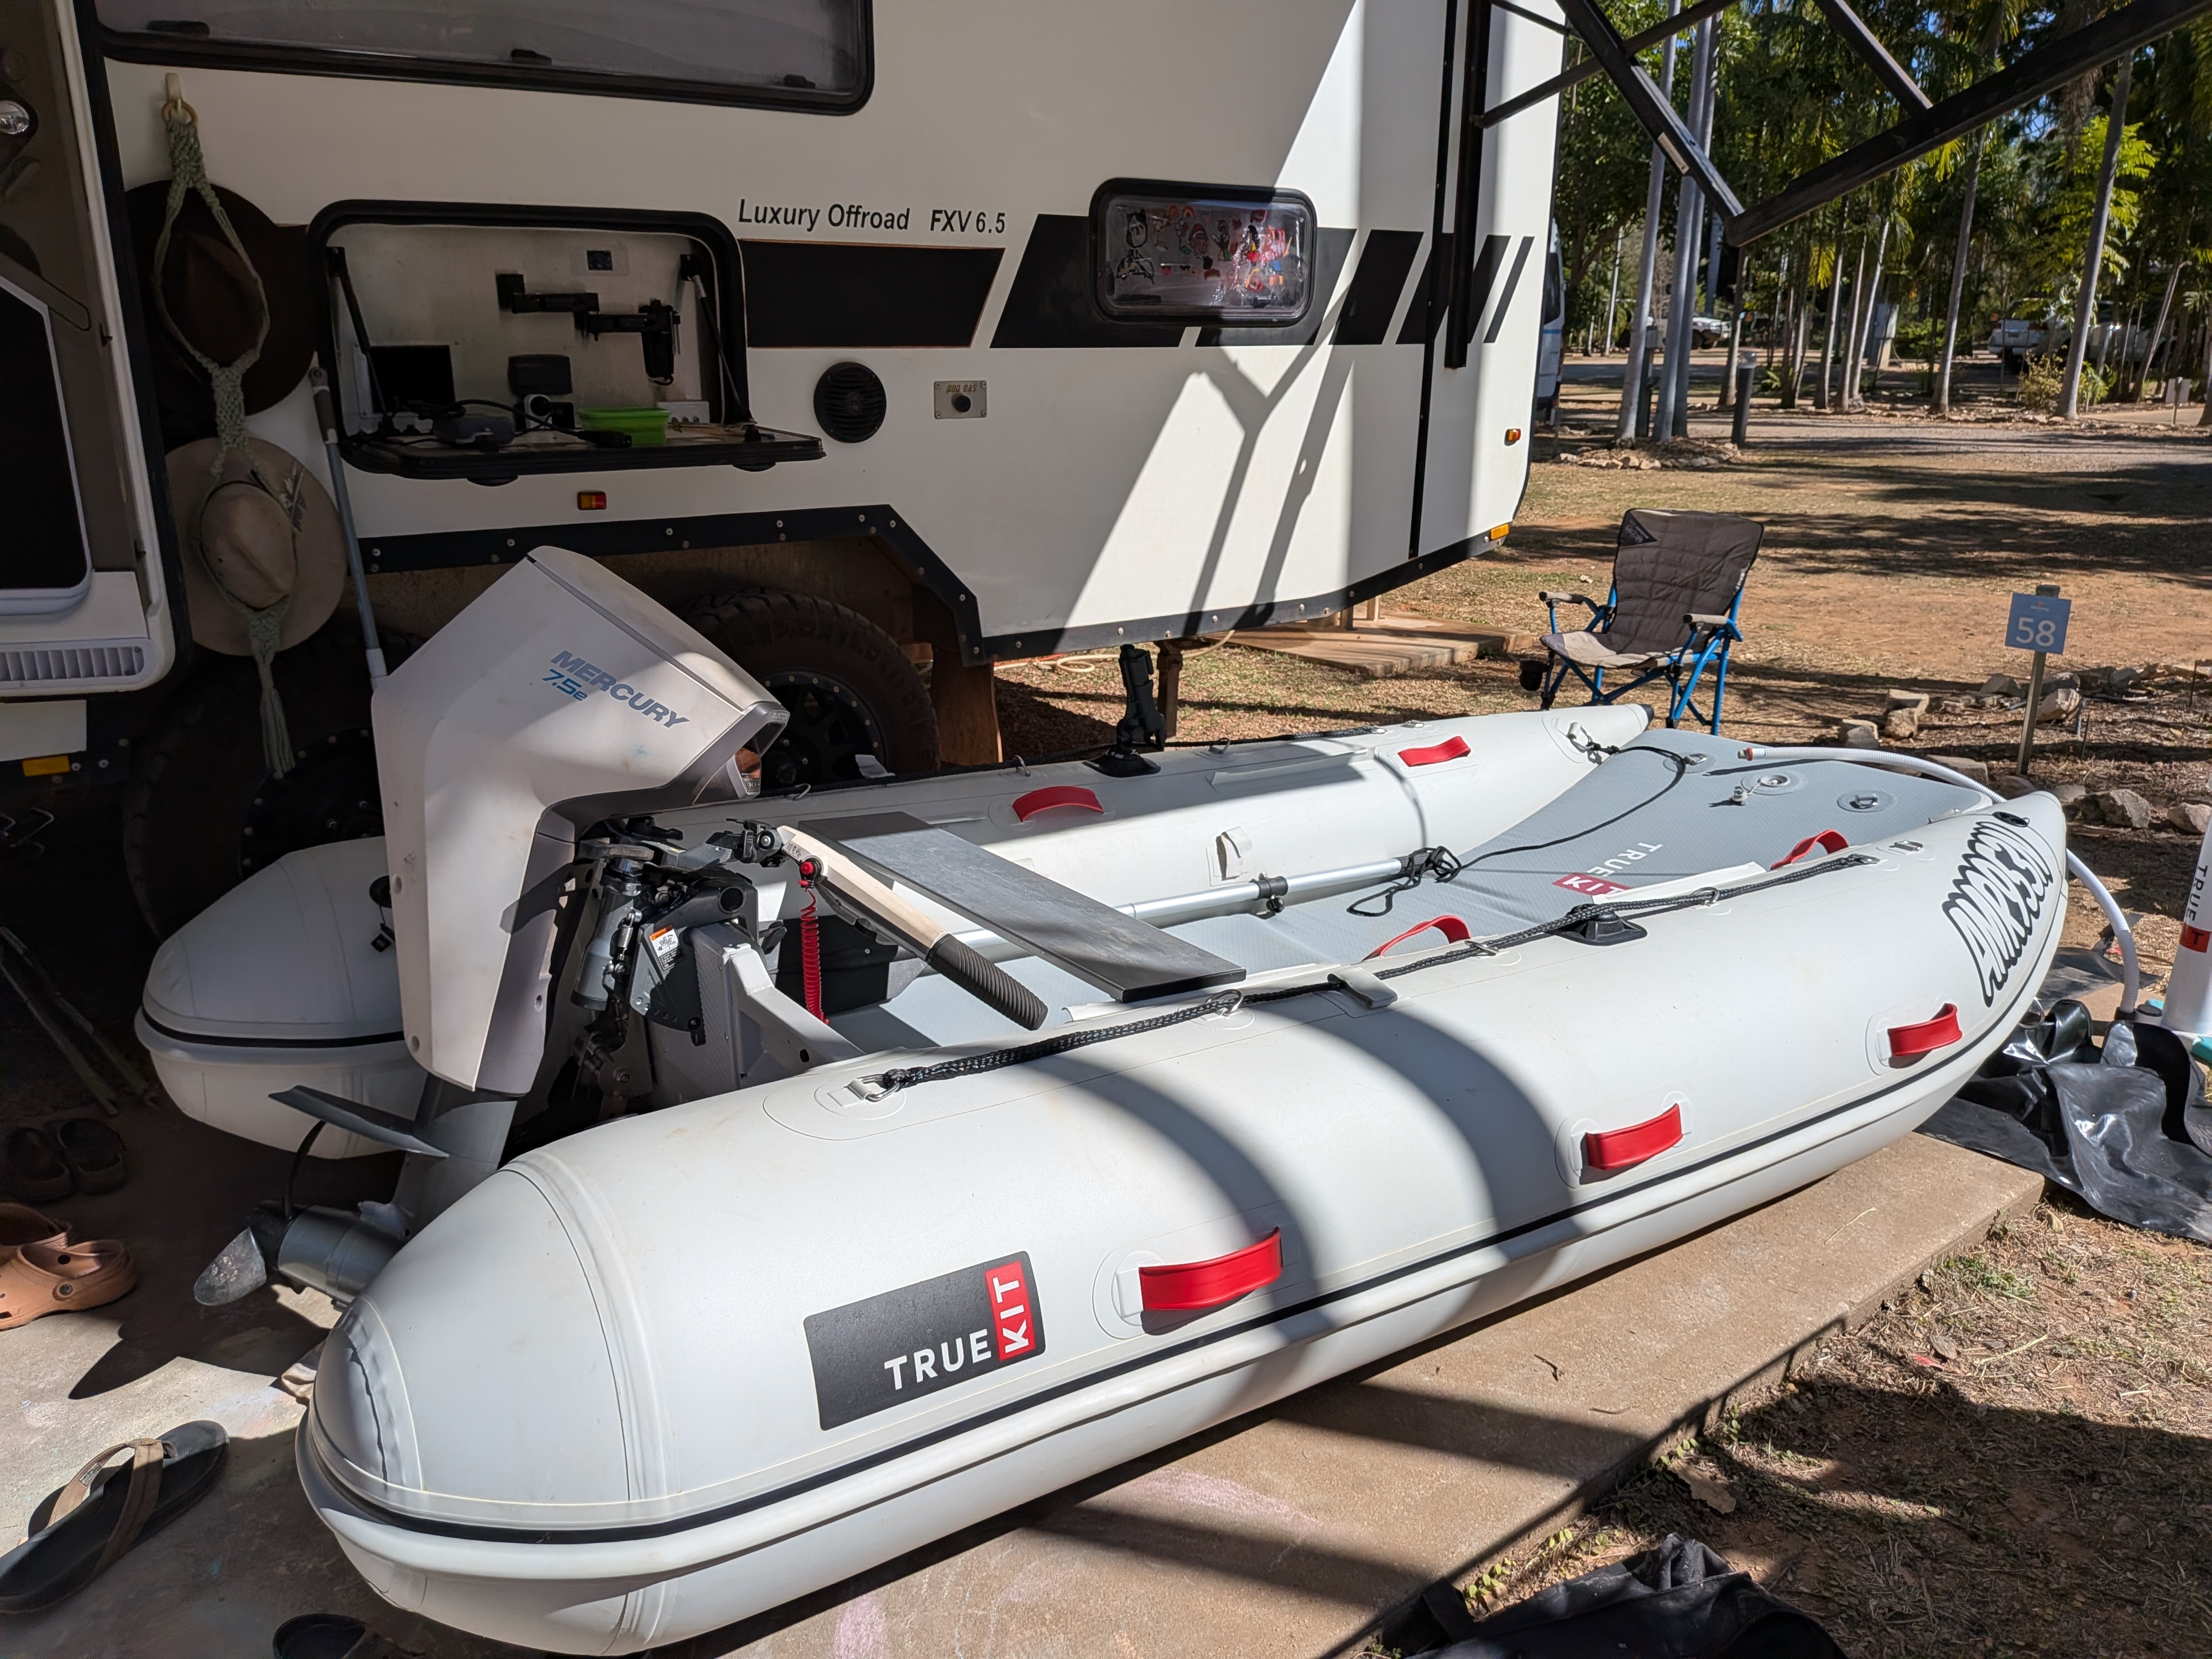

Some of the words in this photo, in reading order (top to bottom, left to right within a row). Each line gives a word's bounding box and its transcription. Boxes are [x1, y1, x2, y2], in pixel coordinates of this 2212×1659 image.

[738, 199, 821, 232] Luxury
[828, 203, 910, 230] Offroad
[930, 209, 972, 233] FXV
[975, 212, 1006, 234] 6.5
[963, 384, 978, 393] GAS
[2016, 617, 2056, 647] 58
[542, 668, 588, 702] 7.5e
[551, 650, 690, 728] MERCURY
[1586, 842, 1663, 878] TRUE
[1562, 876, 1626, 896] KIT
[2185, 865, 2209, 922] TRUE
[884, 1328, 992, 1391] TRUE
[993, 1276, 1030, 1354] KIT
